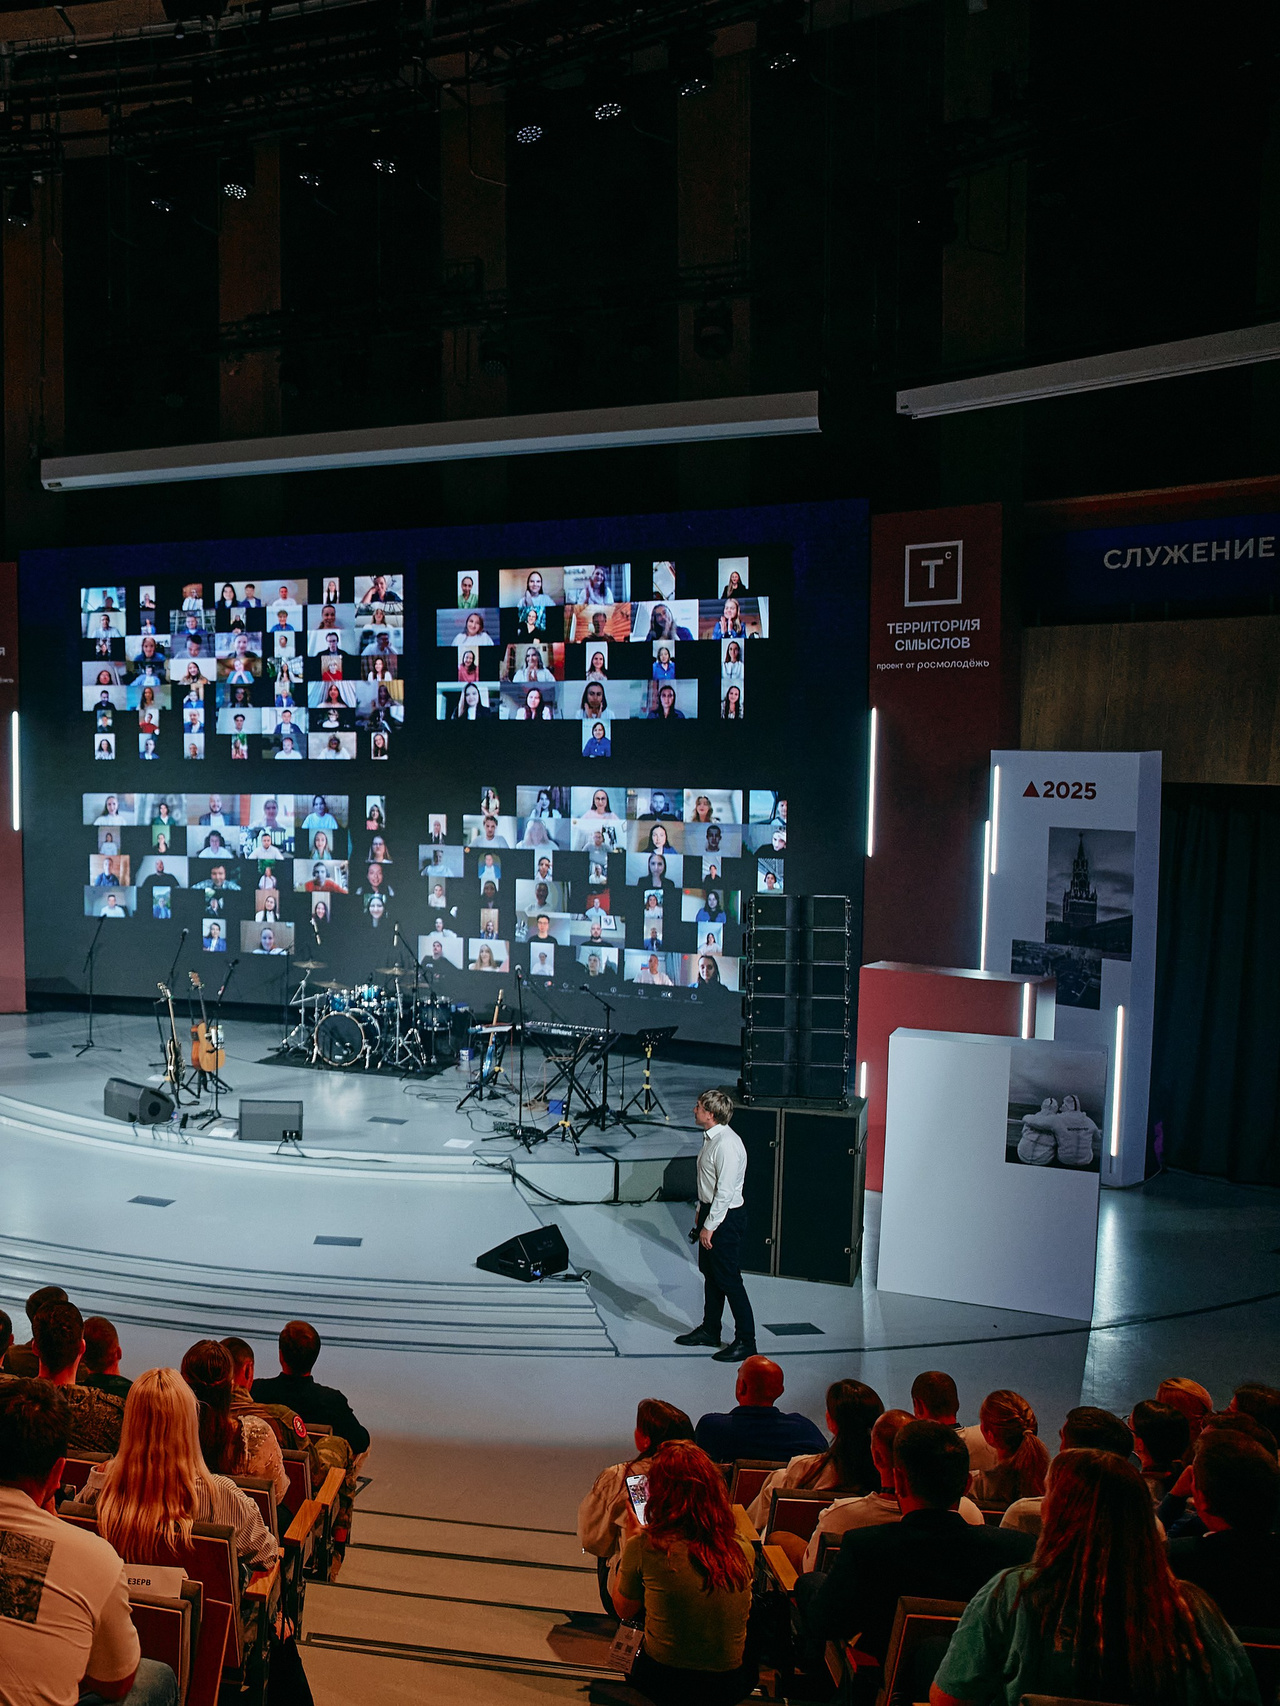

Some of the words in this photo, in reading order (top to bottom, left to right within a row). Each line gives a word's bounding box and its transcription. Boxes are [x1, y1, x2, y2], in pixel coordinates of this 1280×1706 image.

[1103, 536, 1276, 570] СЛУЖЕНИЕ
[886, 618, 981, 635] ТЕРРИТОРИЯ
[894, 636, 971, 652] СМЫСЛОВ
[876, 662, 904, 672] проект
[905, 661, 915, 669] от
[916, 658, 990, 672] росмолодёжь
[1043, 781, 1097, 800] 2025
[127, 1577, 151, 1586] ЕЗЕРВ
